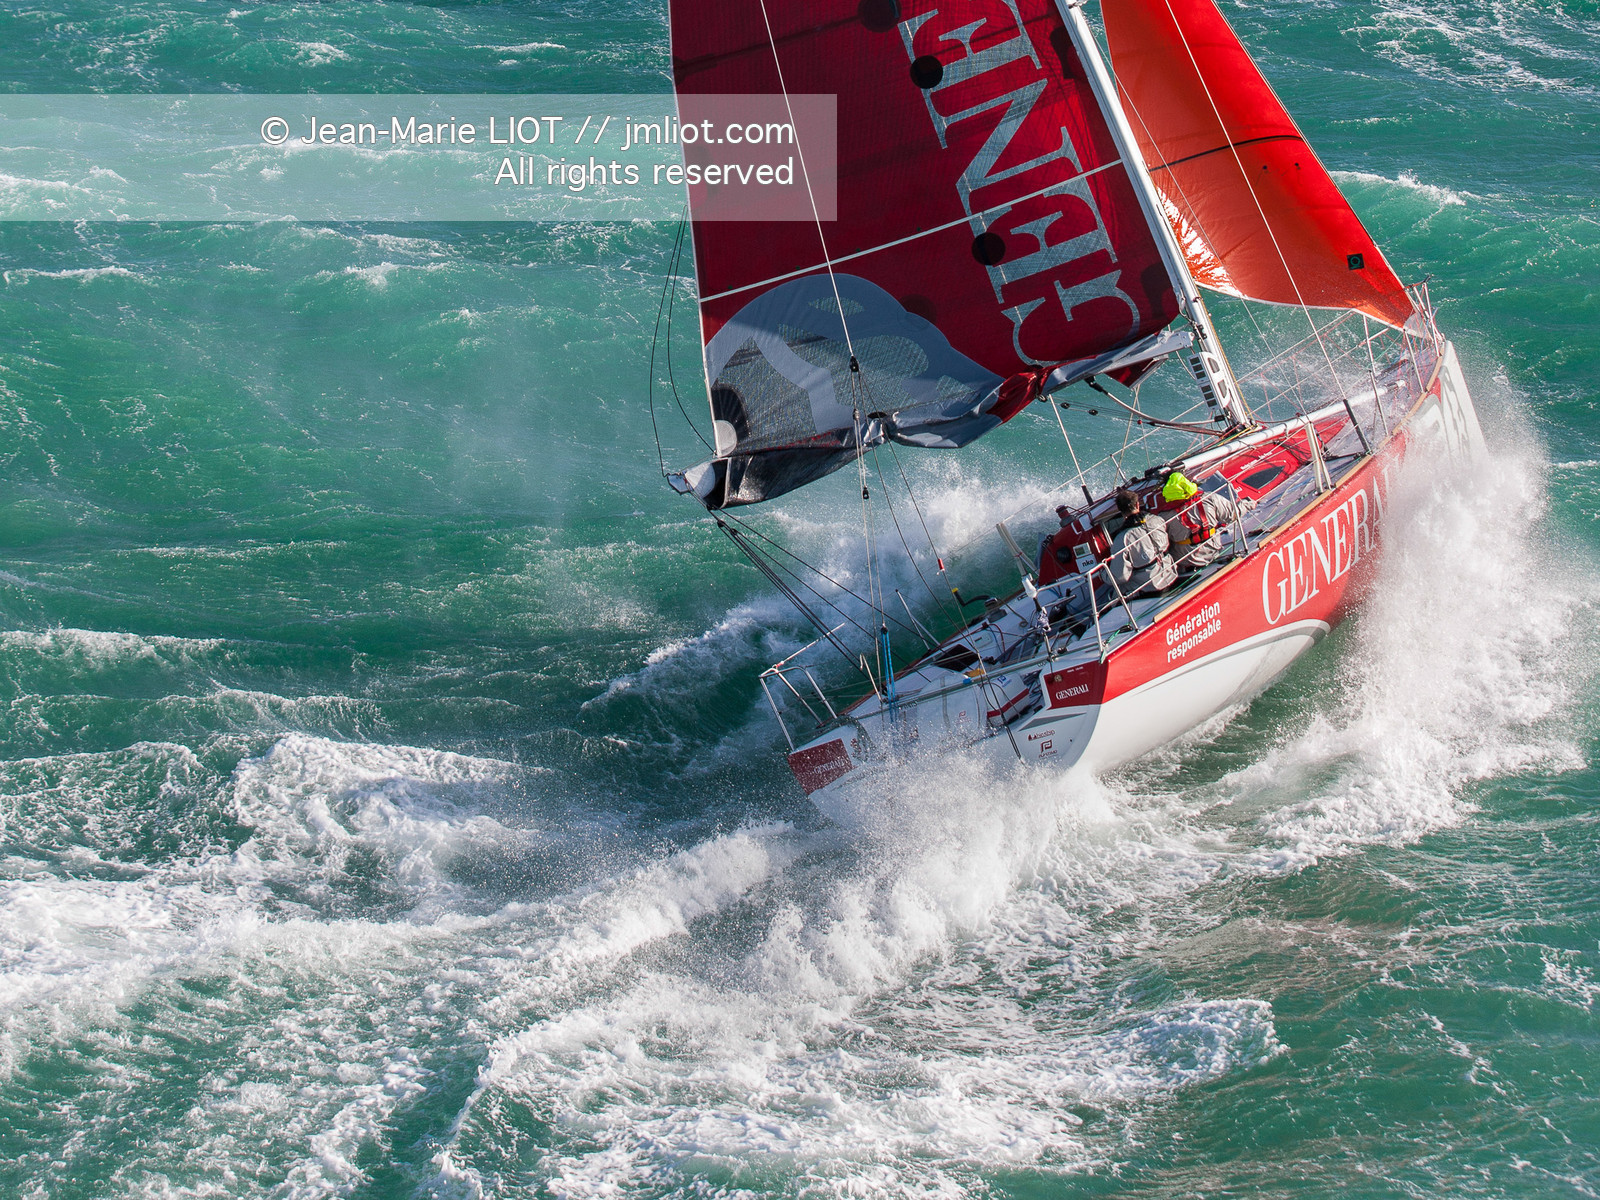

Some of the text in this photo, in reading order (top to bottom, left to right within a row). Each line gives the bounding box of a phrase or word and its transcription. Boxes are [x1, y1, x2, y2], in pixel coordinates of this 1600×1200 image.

[1166, 601, 1220, 646] Génération
[1167, 619, 1221, 663] responsable
[1055, 683, 1089, 700] GENERALI
